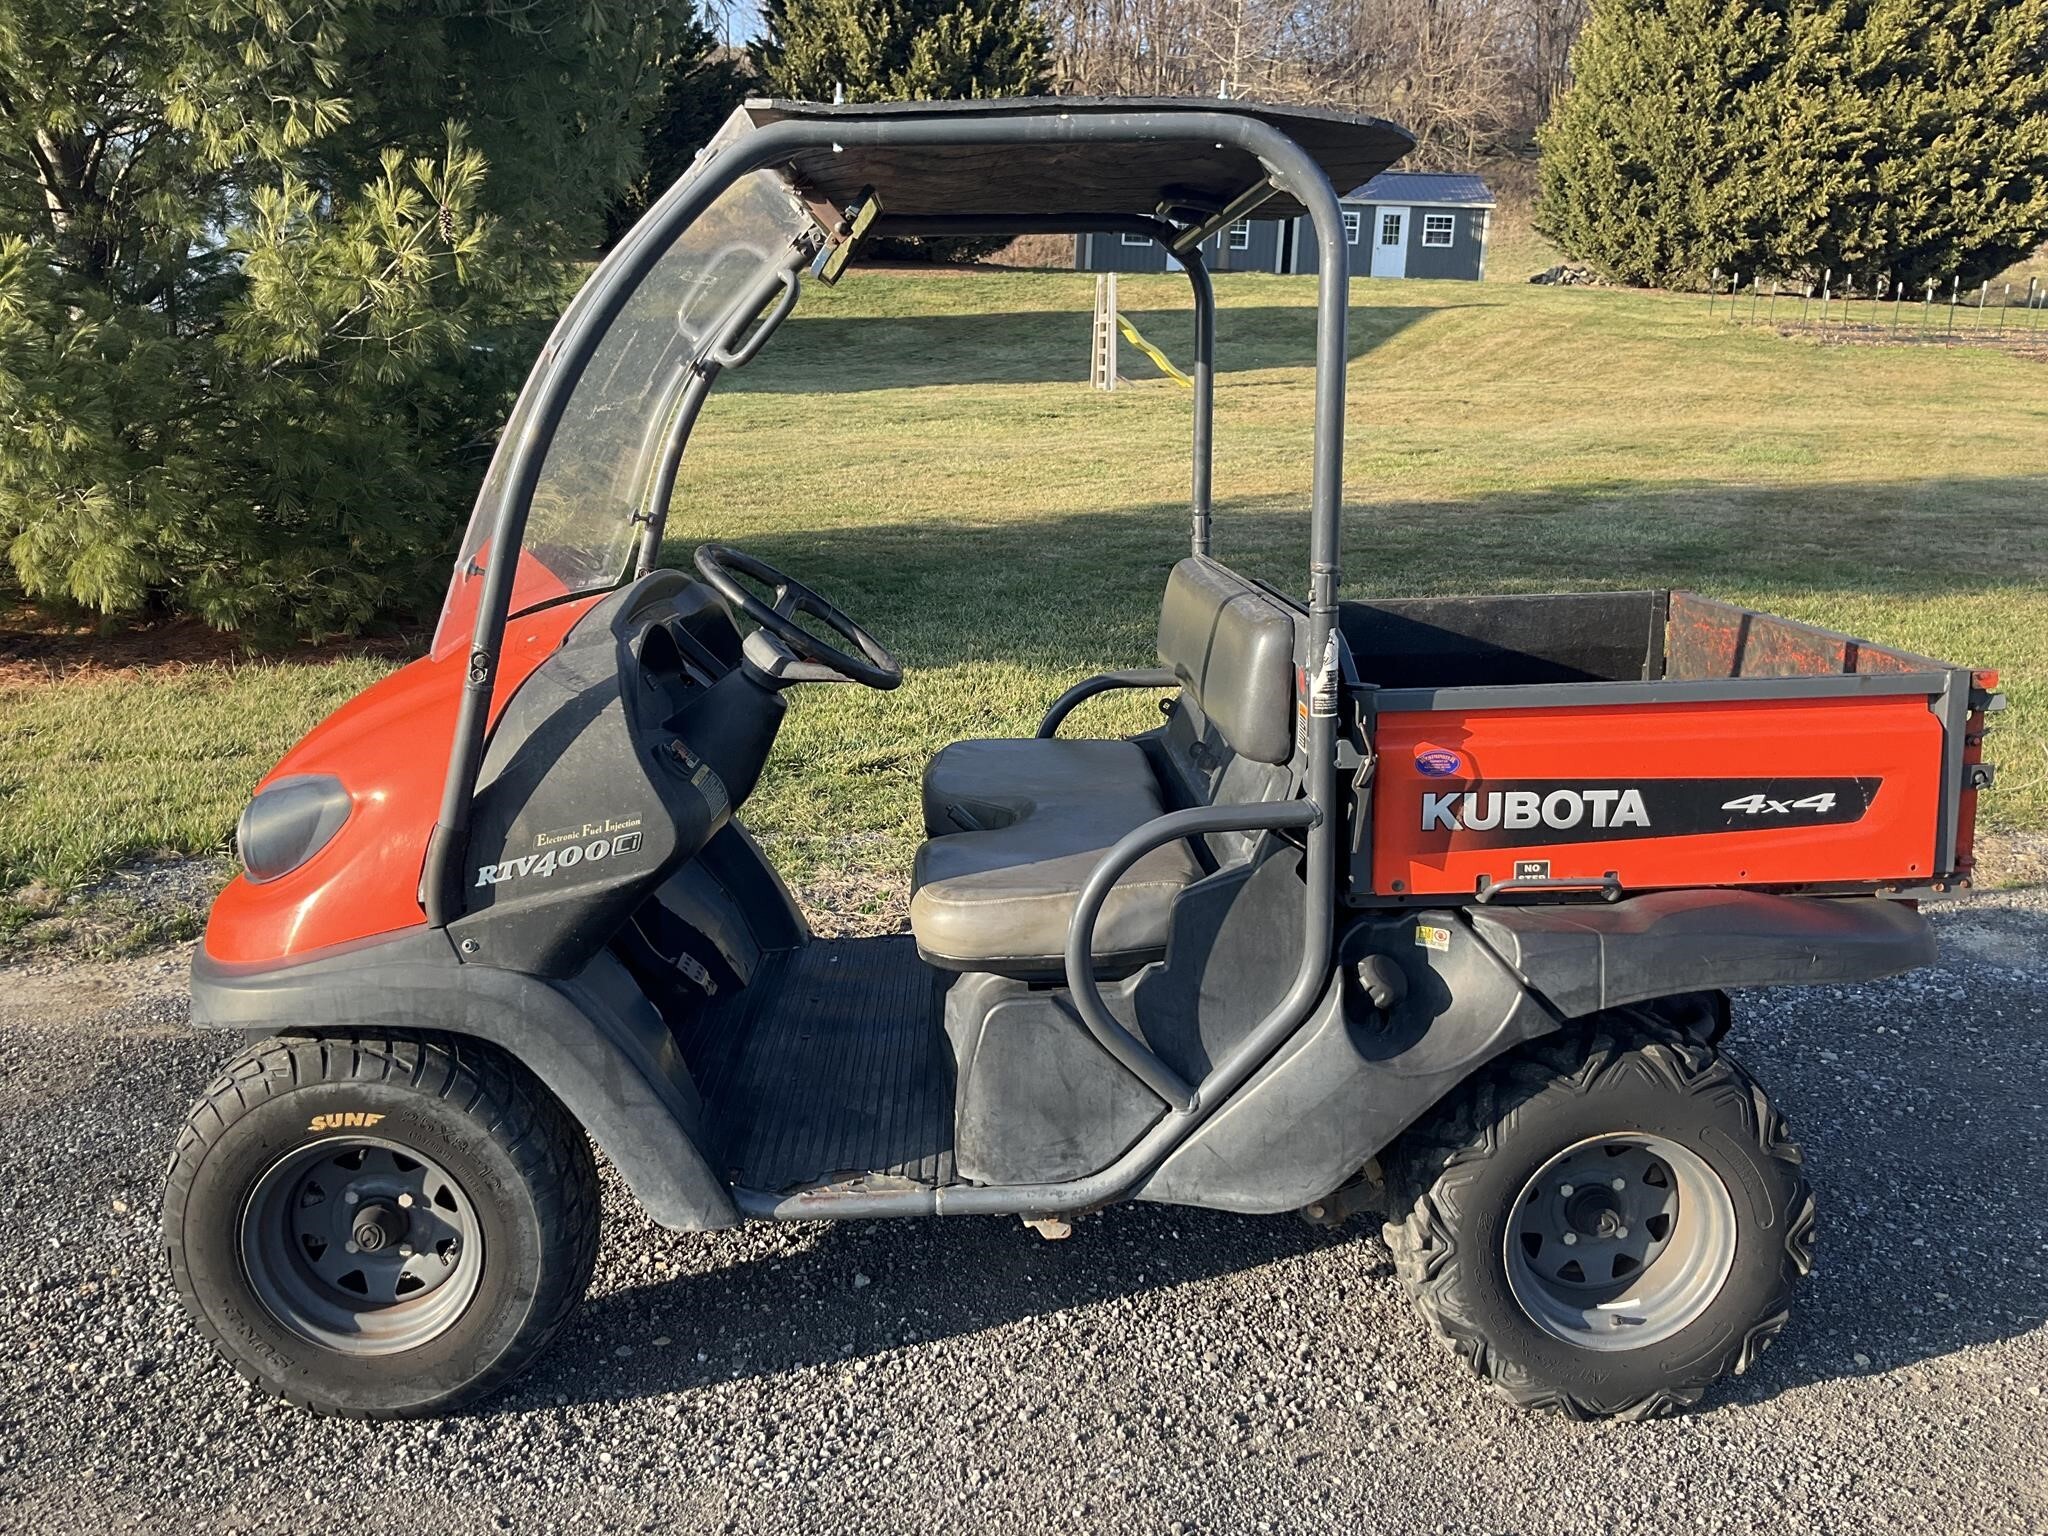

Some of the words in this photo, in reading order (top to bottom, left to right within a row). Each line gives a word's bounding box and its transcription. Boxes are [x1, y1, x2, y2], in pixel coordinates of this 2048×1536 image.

[1421, 789, 1650, 831] KUBOTA
[1721, 793, 1837, 814] 4x4
[537, 833, 580, 847] Electronic
[582, 824, 602, 838] Fuel
[604, 819, 641, 832] Injection
[1524, 864, 1540, 873] NO
[307, 1112, 386, 1131] SUNF
